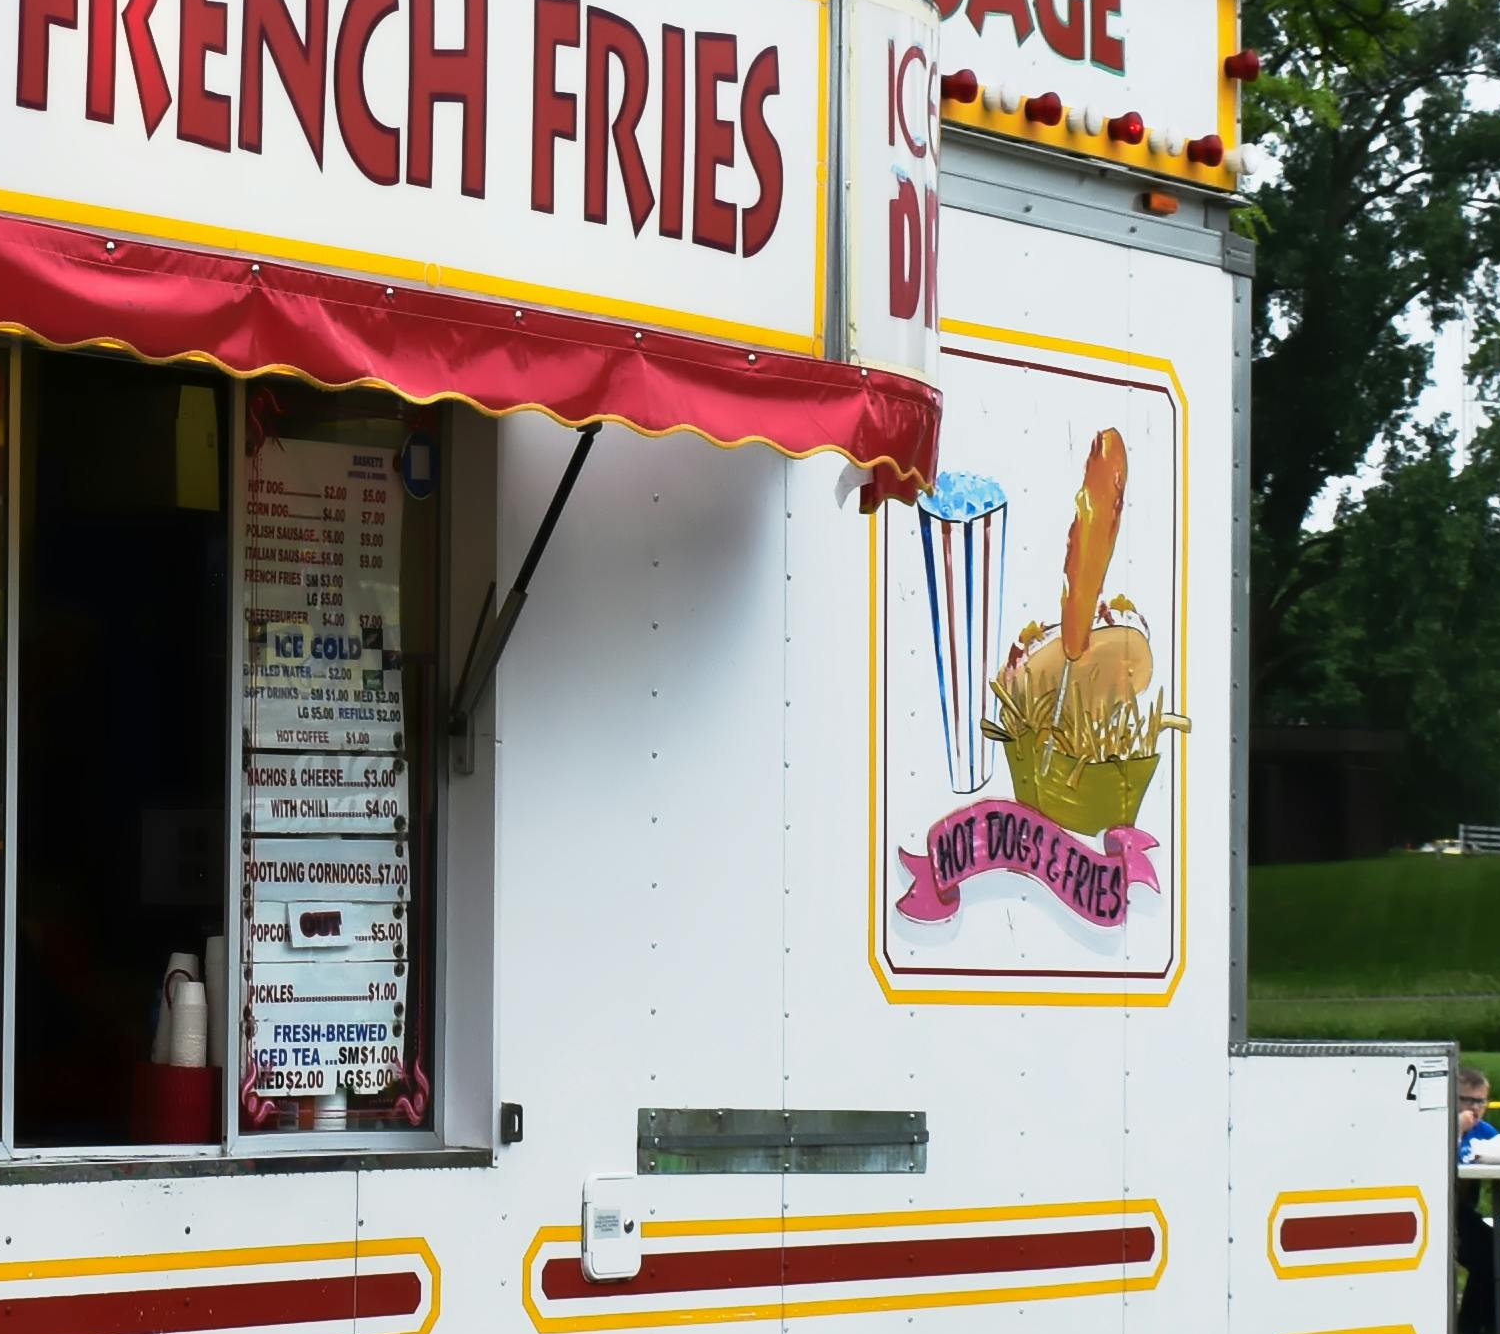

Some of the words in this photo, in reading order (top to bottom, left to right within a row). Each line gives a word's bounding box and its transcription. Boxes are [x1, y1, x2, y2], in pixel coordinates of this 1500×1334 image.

[266, 481, 284, 495] DOG
[323, 486, 347, 501] $2.00
[362, 489, 387, 504] $5.00
[246, 501, 269, 516] CORN
[271, 504, 289, 517] DOG
[323, 507, 346, 523] $4.00
[361, 511, 385, 526] $7.00
[246, 524, 275, 539] POLISH
[276, 527, 315, 542] SAUSAGE
[245, 546, 277, 561] ITALIAN
[360, 555, 383, 569] $9.00
[244, 569, 276, 584] FRENCH
[278, 572, 301, 586] FRIES
[306, 574, 319, 588] SM
[320, 574, 344, 589] $3.00
[306, 593, 318, 606] LG
[320, 592, 343, 607] $5.00
[244, 609, 309, 625] CHEESEBURGER
[322, 613, 345, 628] $4.00
[275, 634, 304, 659] ICE
[311, 634, 362, 661] COLD
[243, 664, 281, 677] BOTTLED
[283, 666, 312, 679] WATER
[328, 667, 352, 681] $2.00
[243, 685, 265, 699] SOFT
[267, 687, 298, 700] DRINKS
[310, 687, 324, 701] SM
[325, 688, 349, 703] $1.00
[353, 689, 373, 703] MED
[375, 690, 400, 704] $2.00
[297, 706, 309, 719] LG
[311, 706, 334, 721] $5.00
[338, 707, 375, 721] REFILLS
[376, 708, 401, 723] $2.00
[276, 730, 294, 743] HOT
[296, 730, 330, 744] COFFEE
[346, 731, 370, 745] $1.00
[247, 768, 287, 787] NACHOS
[290, 768, 297, 787] &
[300, 769, 344, 787] CHEESE
[364, 768, 396, 789] $3.00
[271, 799, 297, 818] WITH
[300, 799, 329, 818] CHILI
[365, 799, 398, 820] $4.00
[243, 861, 305, 883] FOOTLONG
[308, 862, 372, 884] CORNDOGS
[378, 862, 408, 885] $7.00
[937, 815, 977, 882] HOT
[985, 811, 1044, 870] DOGS
[1062, 847, 1122, 920] FRIES
[299, 911, 342, 938] OUT
[371, 922, 403, 943] $5.00
[249, 983, 294, 1004] PICKLES
[368, 982, 397, 1003] $1.00
[273, 1023, 387, 1043] FRESH-BREWED
[253, 1047, 288, 1067] ICED
[292, 1048, 321, 1066] TEA
[1406, 1064, 1417, 1101] 2
